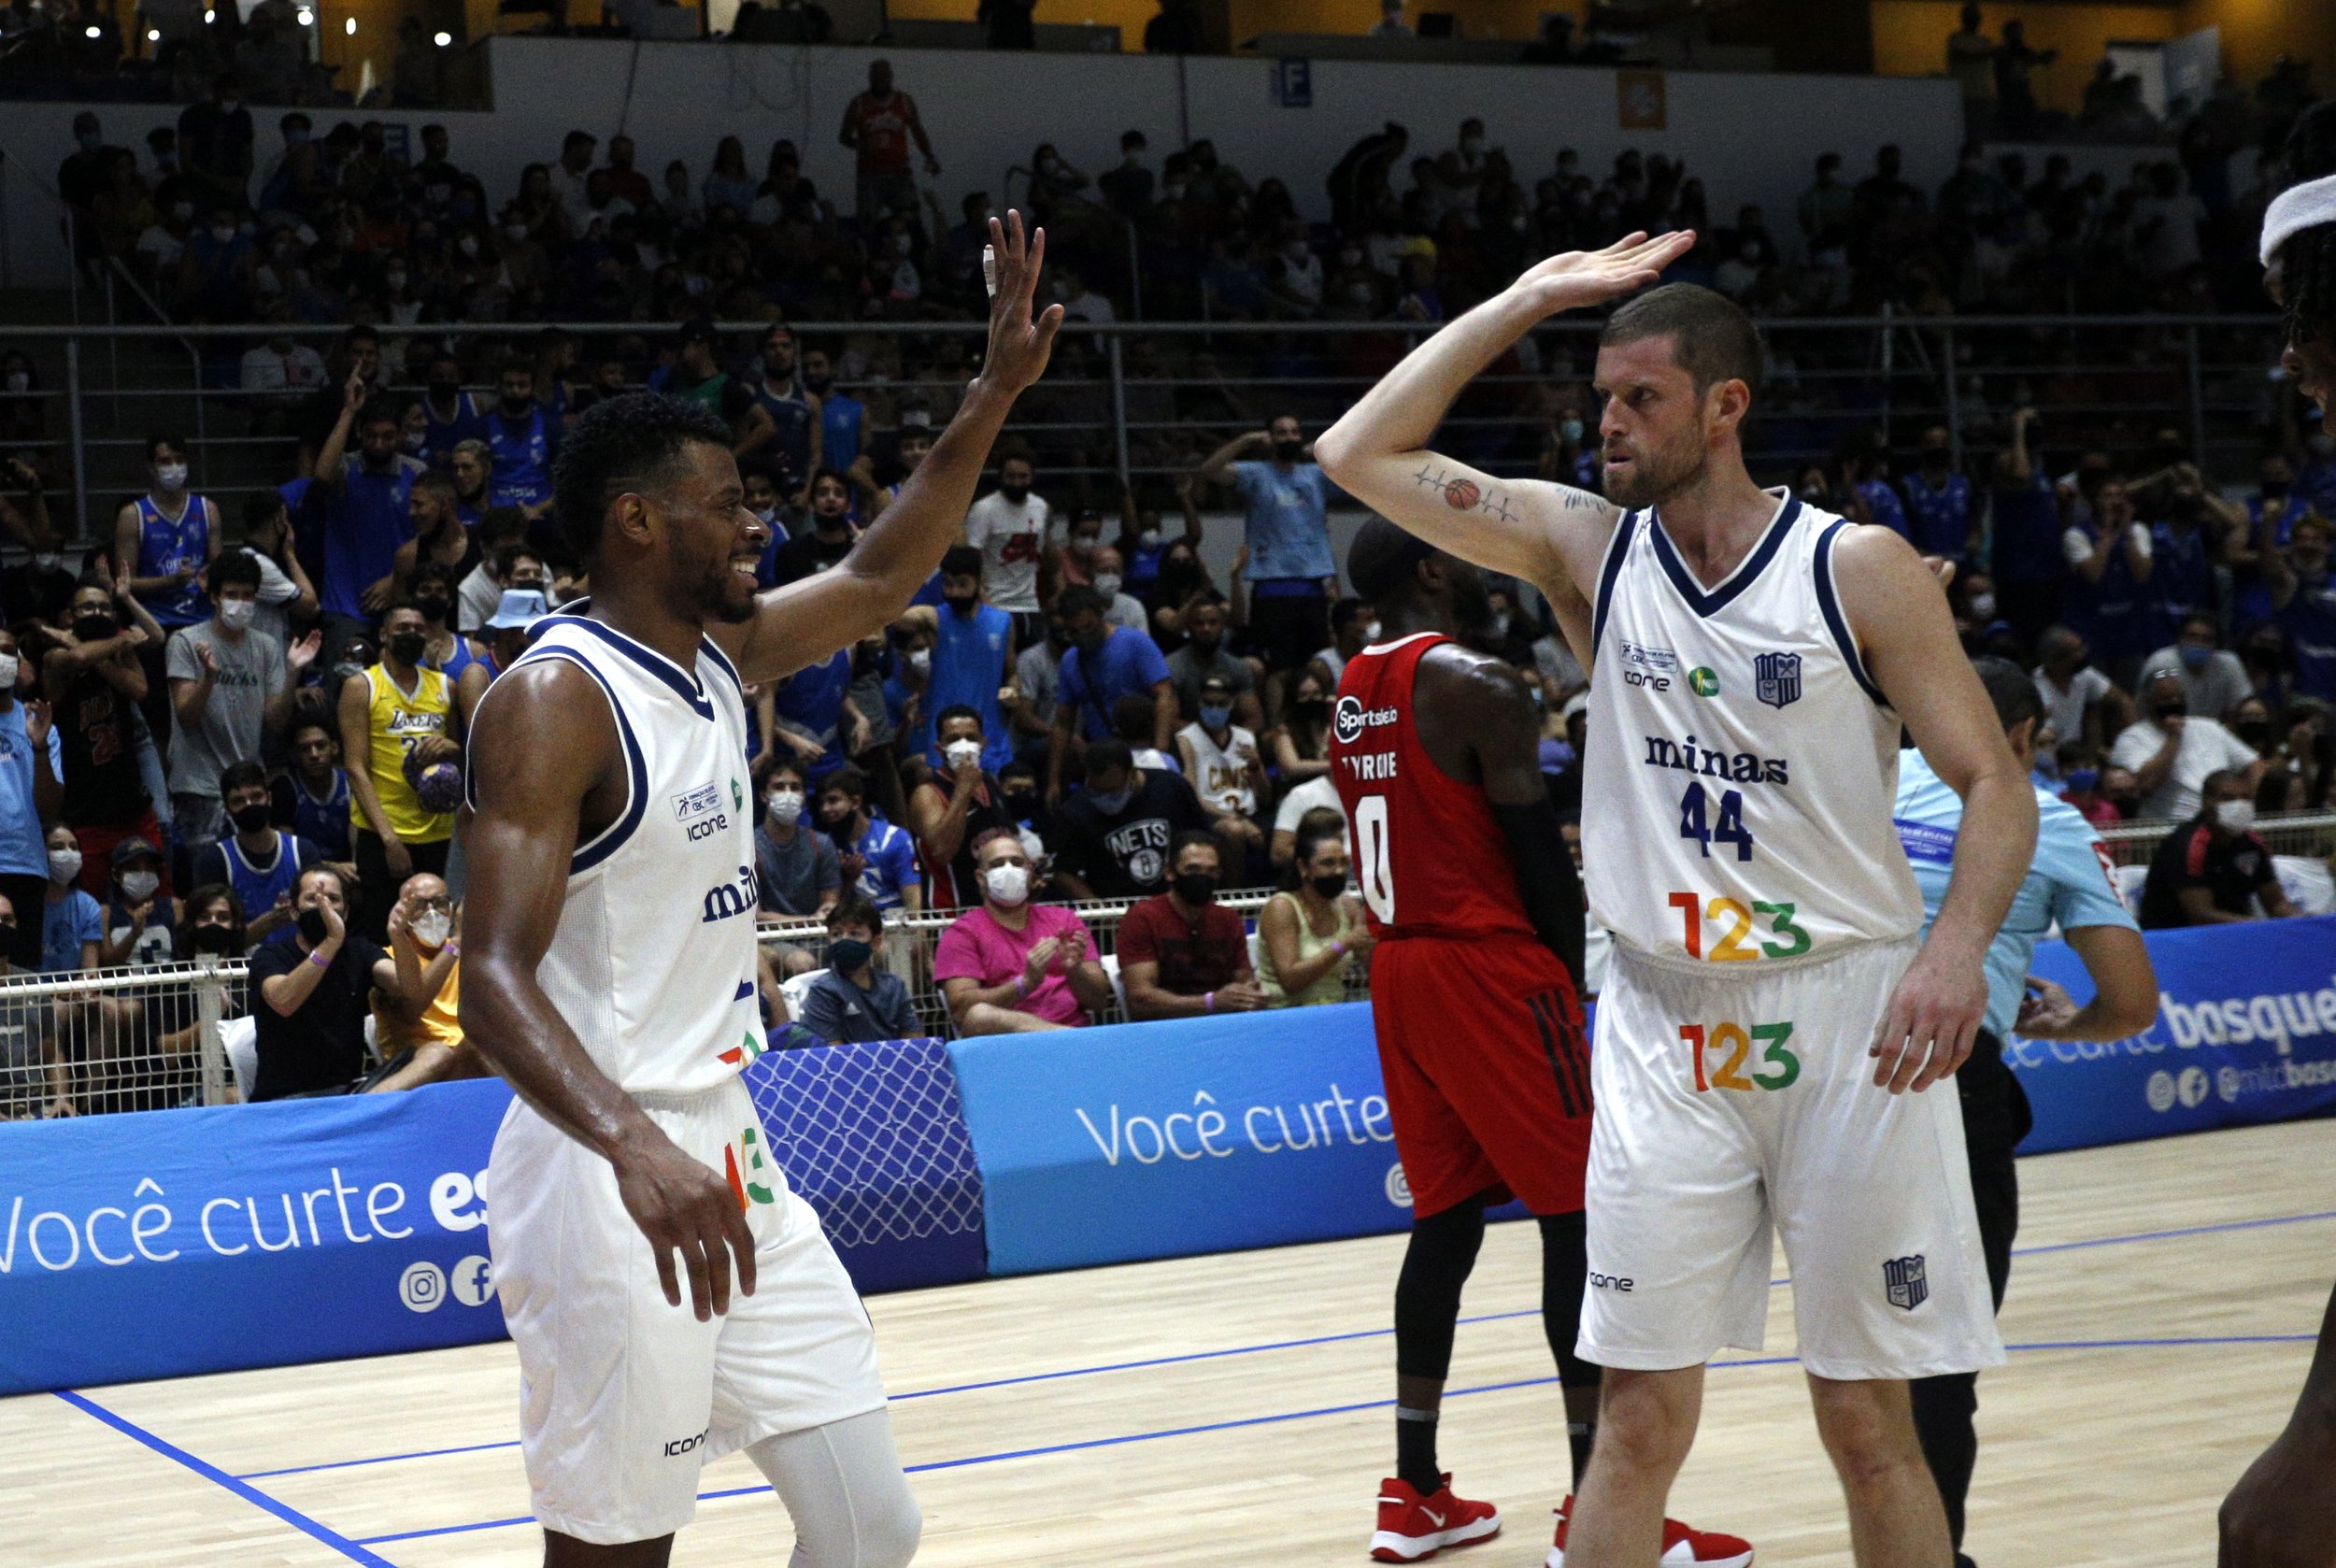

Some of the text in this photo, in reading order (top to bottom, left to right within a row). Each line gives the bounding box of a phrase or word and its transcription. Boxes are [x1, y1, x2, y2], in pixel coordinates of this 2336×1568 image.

[1285, 64, 1305, 93] F
[1645, 735, 1788, 785] minas
[1109, 822, 1169, 859] NETS
[1680, 781, 1753, 862] 44
[1355, 794, 1396, 925] 0
[1669, 892, 1811, 961] 123
[2159, 975, 2336, 1056] basque
[1679, 1021, 1800, 1091] 123
[1075, 1083, 1395, 1166] Você curte
[200, 1167, 414, 1257] curte
